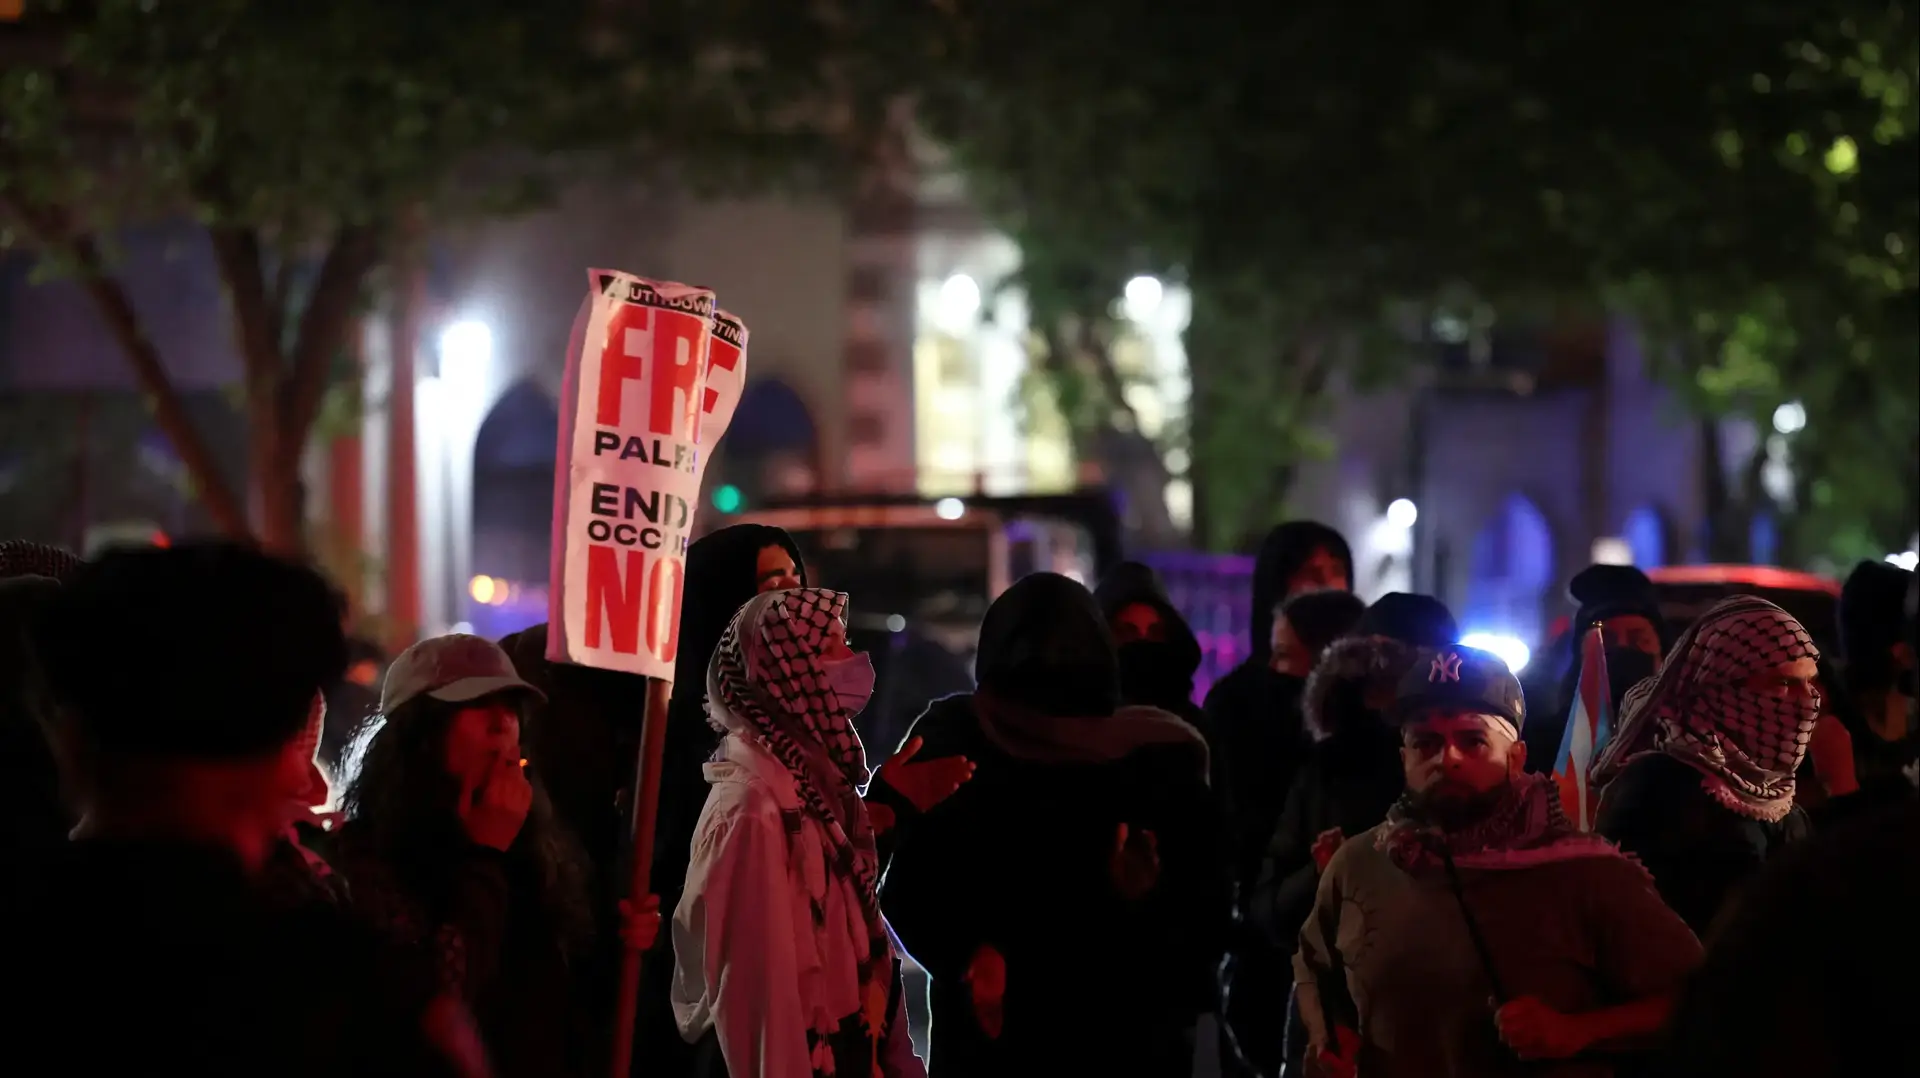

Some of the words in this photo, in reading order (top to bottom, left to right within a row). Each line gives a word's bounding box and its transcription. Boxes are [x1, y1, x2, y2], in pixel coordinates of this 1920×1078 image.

[591, 482, 688, 529] END
[584, 544, 684, 663] NO
[1428, 652, 1462, 682] NY
